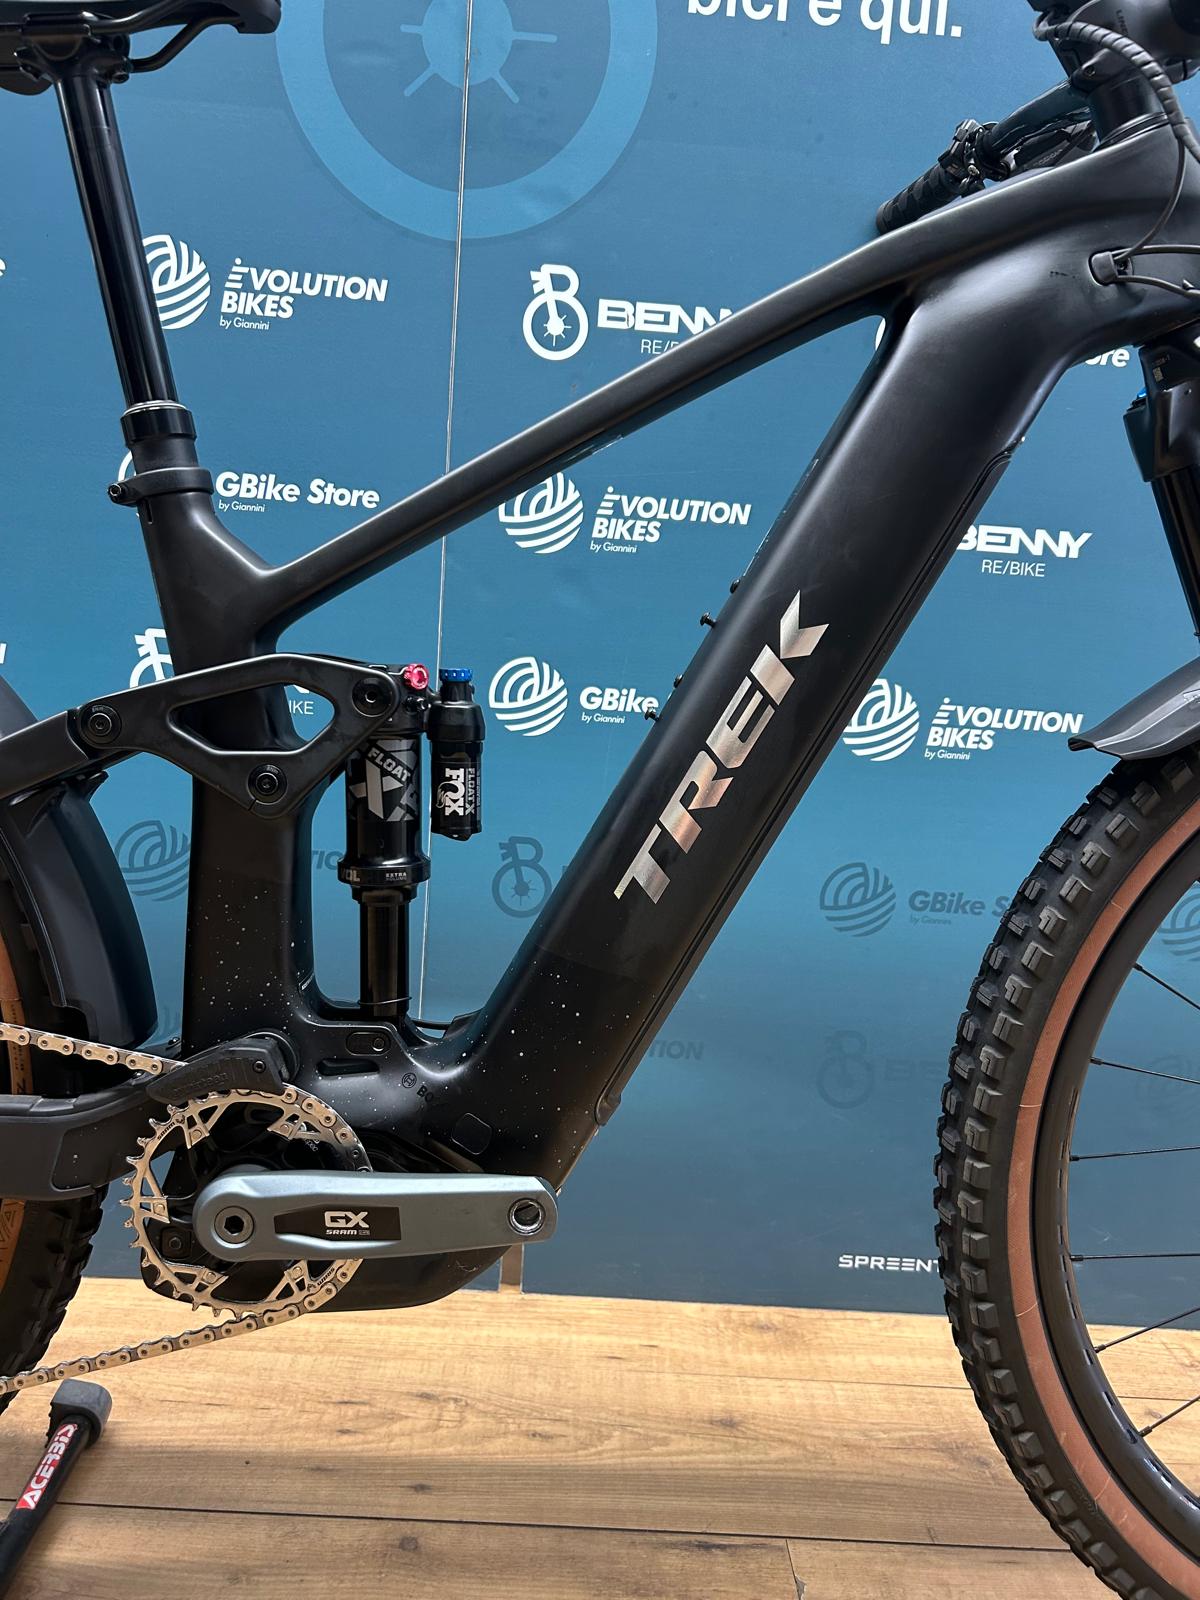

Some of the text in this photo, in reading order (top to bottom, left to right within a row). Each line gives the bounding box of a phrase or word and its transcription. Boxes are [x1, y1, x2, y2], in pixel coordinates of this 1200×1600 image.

[859, 0, 962, 45] qui.
[220, 290, 295, 319] BIKES
[219, 315, 270, 330] by Giannini
[215, 471, 380, 509] GBike Store
[218, 499, 266, 513] by Giannini
[591, 517, 662, 543] BIKES
[589, 540, 638, 553] by Giannini
[981, 559, 1046, 578] RE/BIKE
[579, 686, 660, 714] GBike
[581, 712, 626, 724] by Giannini
[613, 590, 829, 904] TREK
[926, 726, 996, 751] BIKES
[367, 747, 411, 782] FLOAT
[924, 748, 971, 760] by Giannini
[444, 767, 466, 816] FOX
[467, 767, 476, 802] FLOAT
[908, 889, 987, 916] GBike
[324, 1211, 370, 1228] GX
